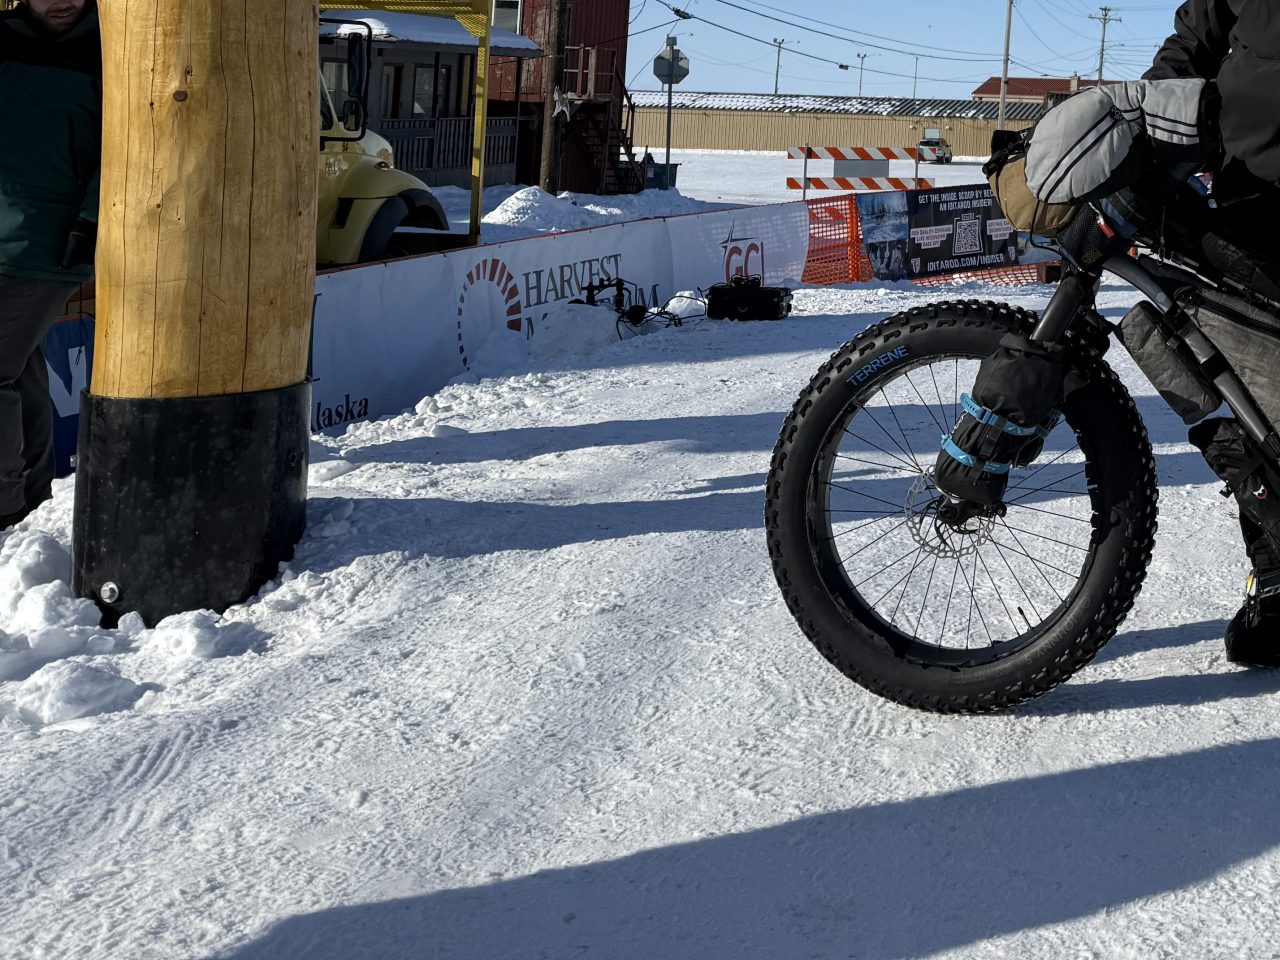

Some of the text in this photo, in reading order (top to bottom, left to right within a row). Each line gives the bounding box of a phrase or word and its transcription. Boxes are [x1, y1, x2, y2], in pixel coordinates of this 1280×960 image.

[918, 194, 929, 204] GET
[930, 193, 940, 203] THE
[941, 192, 957, 202] INSIDE
[958, 191, 975, 200] SCOOP
[975, 190, 983, 199] BY
[948, 200, 971, 211] IDITAROD
[725, 241, 765, 286] GCI
[927, 255, 1004, 272] IDITAROD.COM/INSIDER
[522, 253, 622, 309] HARVEST
[846, 345, 909, 386] TERRENE
